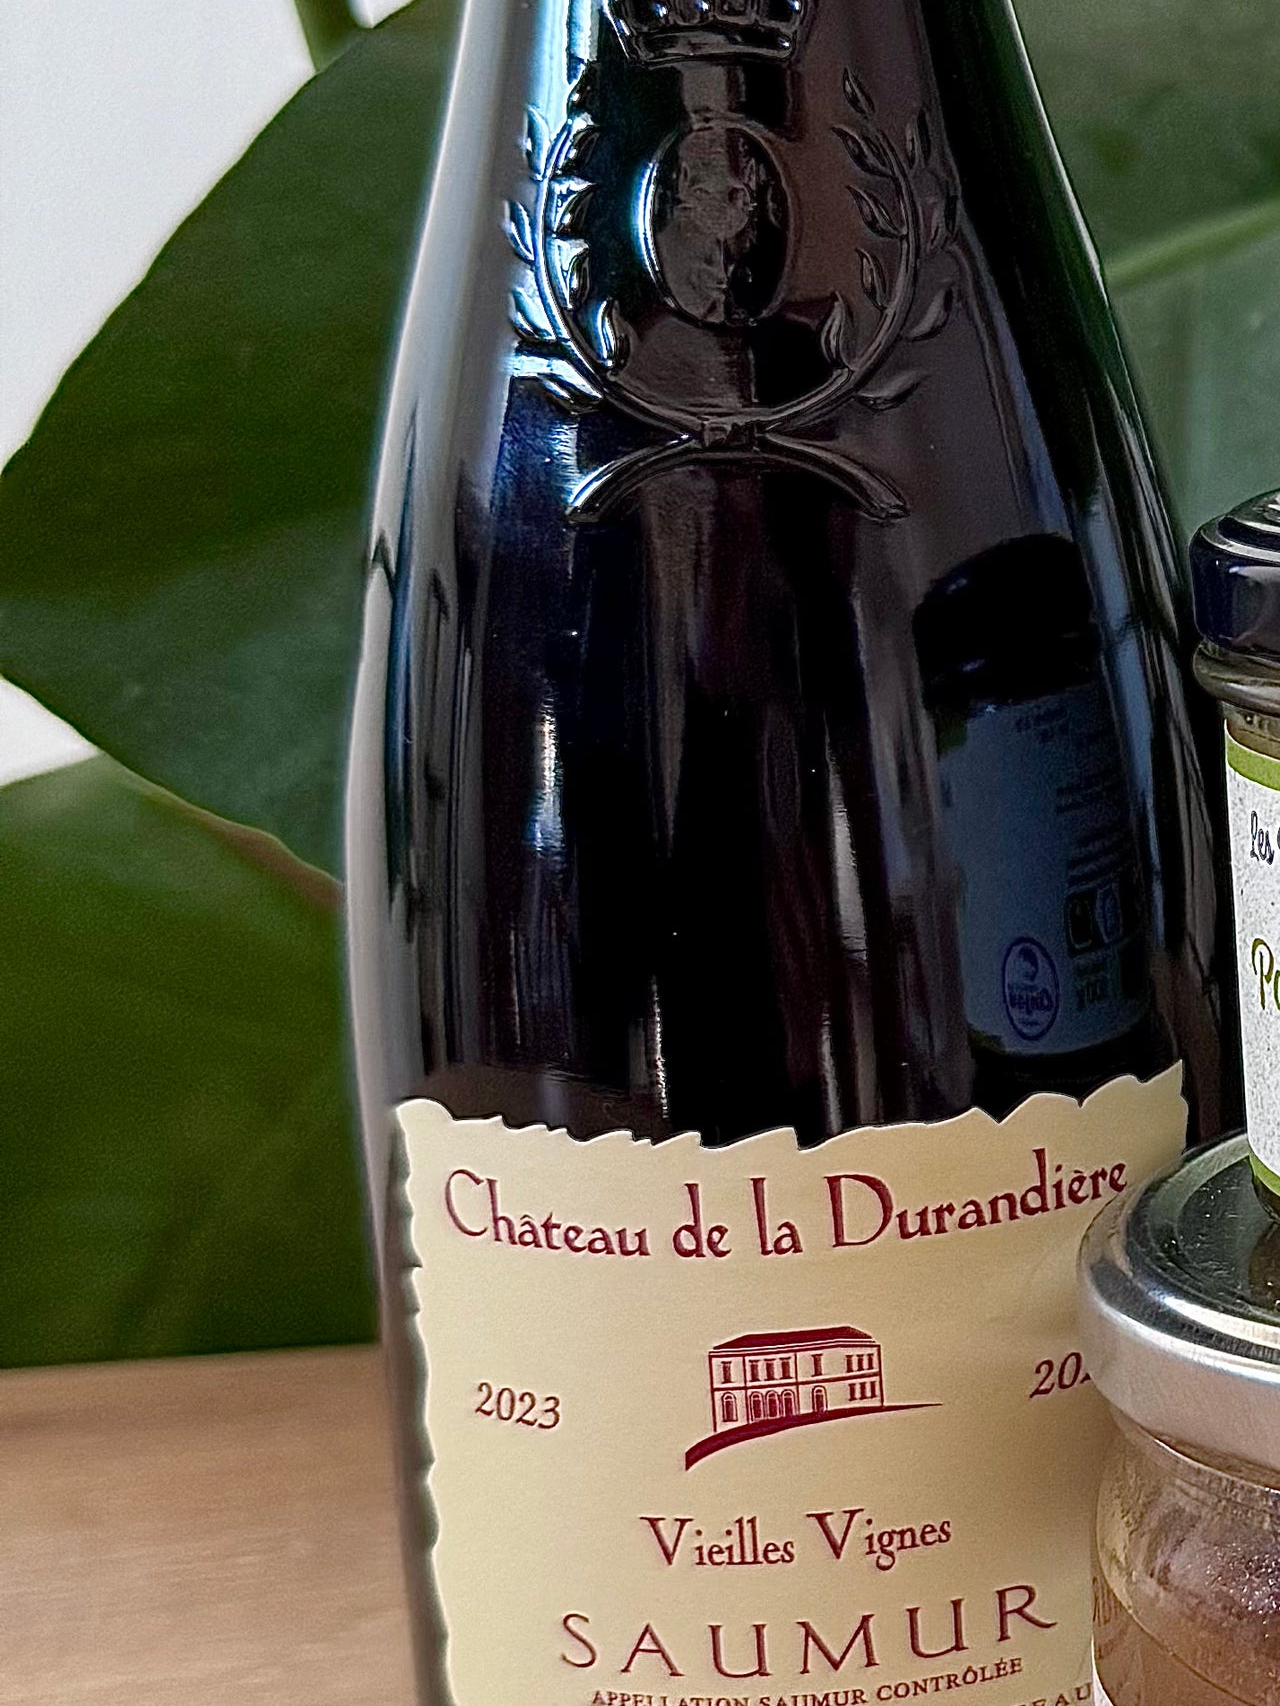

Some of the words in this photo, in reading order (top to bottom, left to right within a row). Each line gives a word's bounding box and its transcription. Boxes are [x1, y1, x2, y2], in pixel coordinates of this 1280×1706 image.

[1251, 811, 1274, 865] Les
[445, 1169, 649, 1257] Château
[673, 1184, 731, 1259] de
[751, 1178, 802, 1256] la
[825, 1148, 1127, 1250] Durandière
[1031, 1351, 1092, 1401] 20
[476, 1382, 561, 1431] 2023
[641, 1517, 794, 1567] Vieilles
[807, 1508, 952, 1572] Vignes
[561, 1585, 1057, 1679] SAUMUR
[876, 1656, 1023, 1703] CONTRÔLÉE
